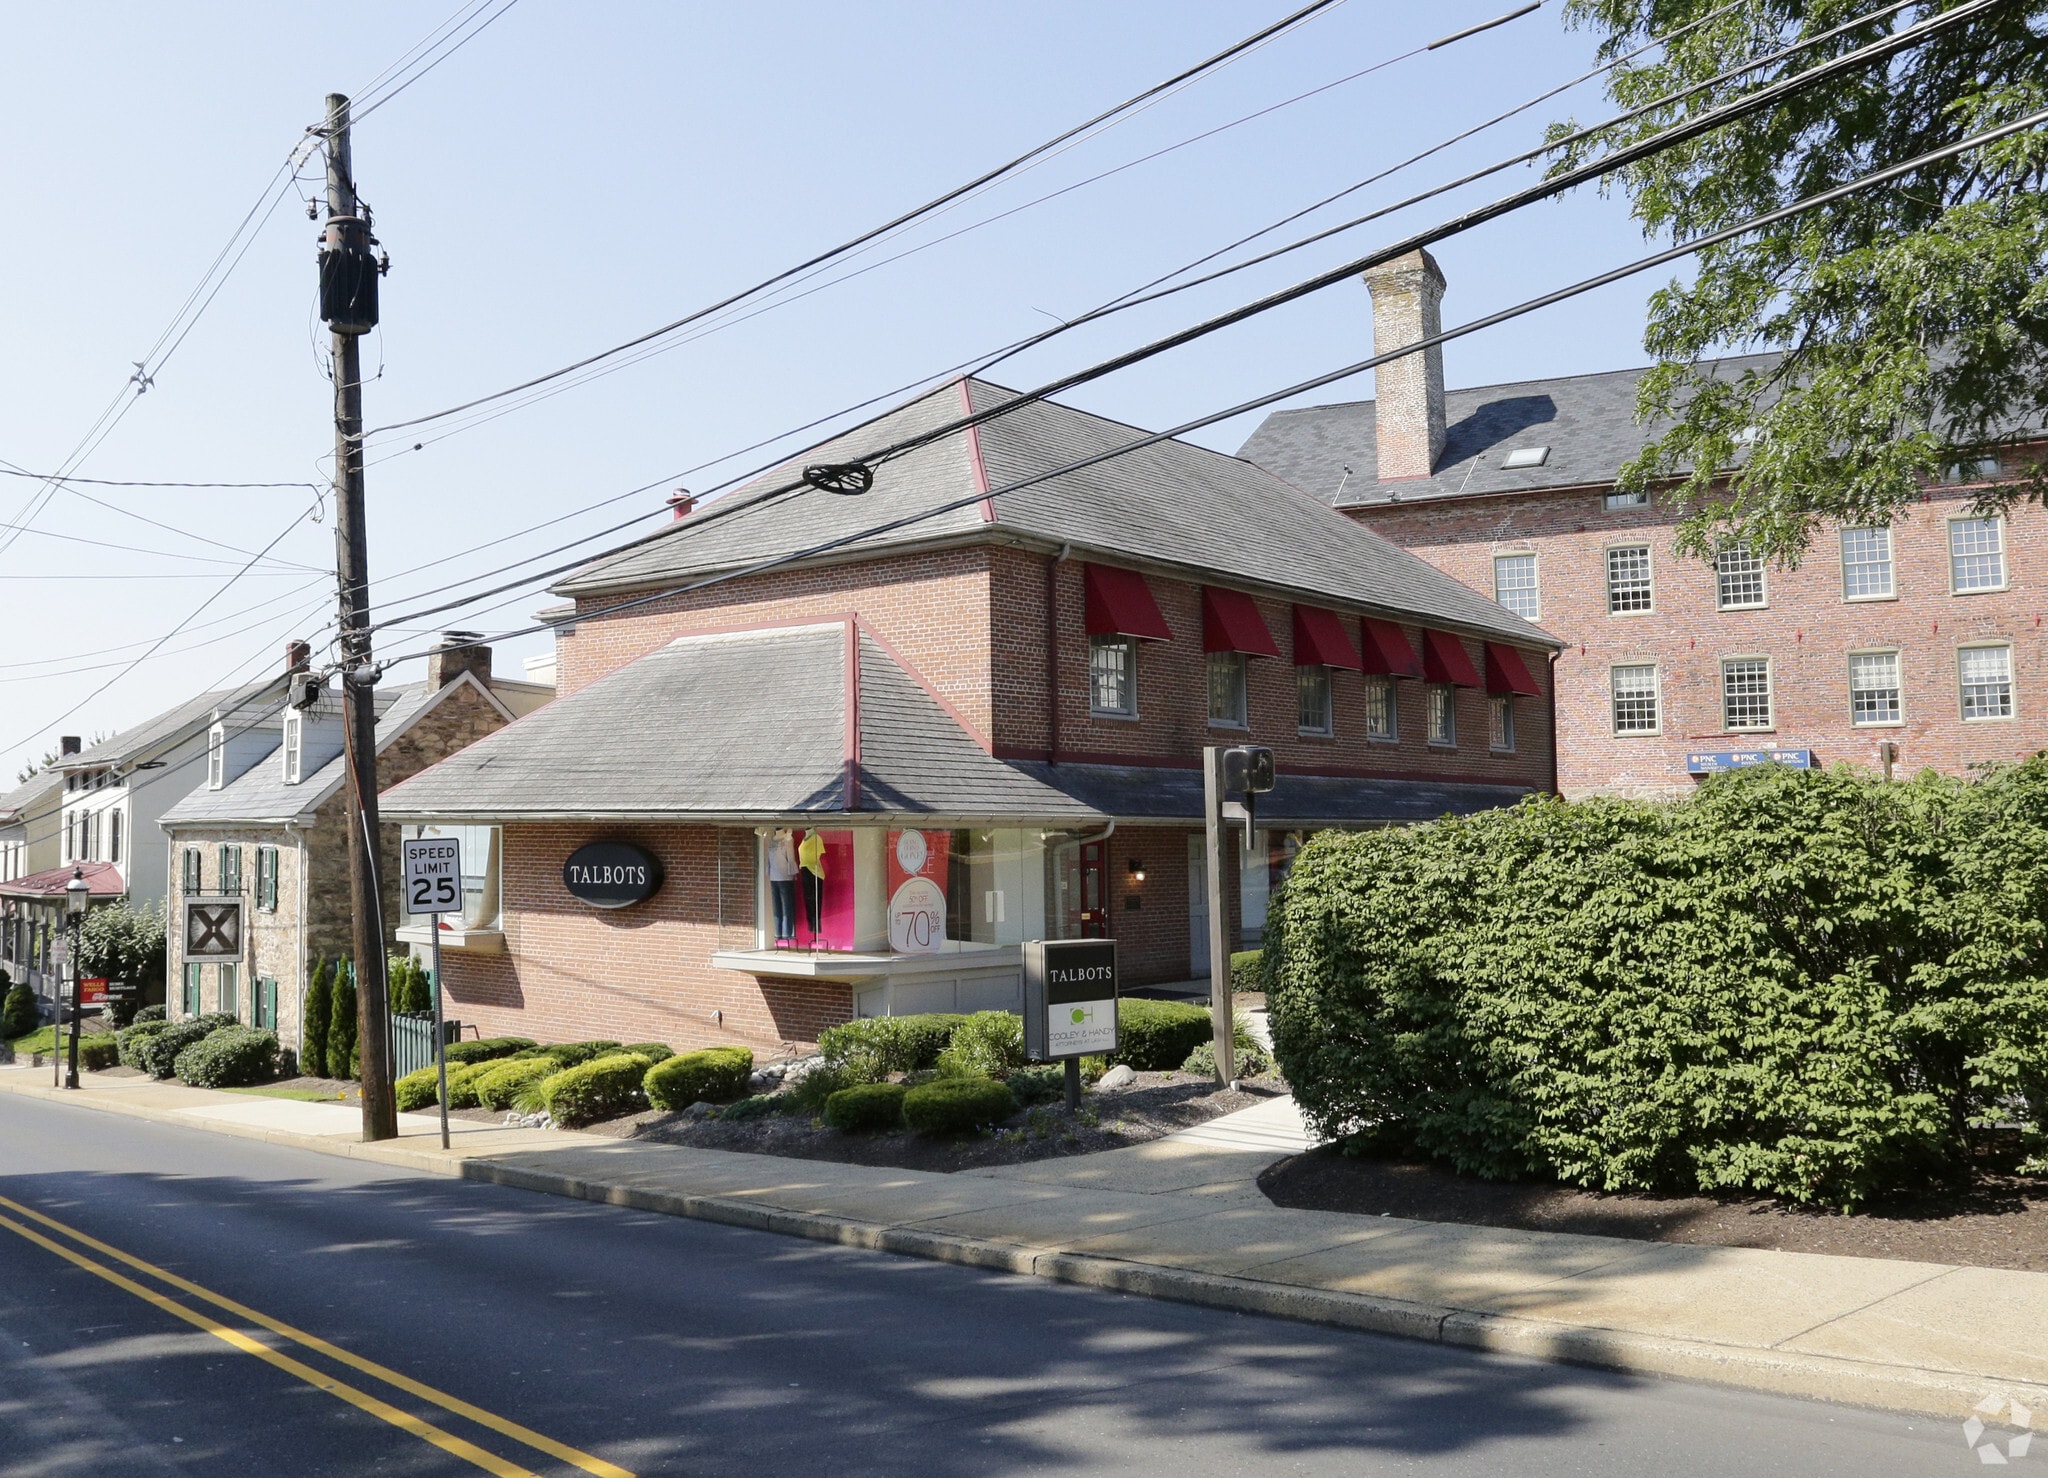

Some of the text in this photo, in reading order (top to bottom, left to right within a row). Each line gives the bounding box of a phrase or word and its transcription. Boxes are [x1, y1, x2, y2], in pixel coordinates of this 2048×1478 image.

[409, 847, 455, 859] SPEED
[415, 862, 450, 874] LIMIT
[570, 865, 645, 885] TALBOTS
[412, 877, 455, 905] 25
[902, 911, 930, 948] 70
[930, 925, 941, 933] OFF
[1050, 966, 1112, 982] TALBOTS
[1049, 1031, 1080, 1041] COOLEY
[1088, 1027, 1115, 1037] HANDY
